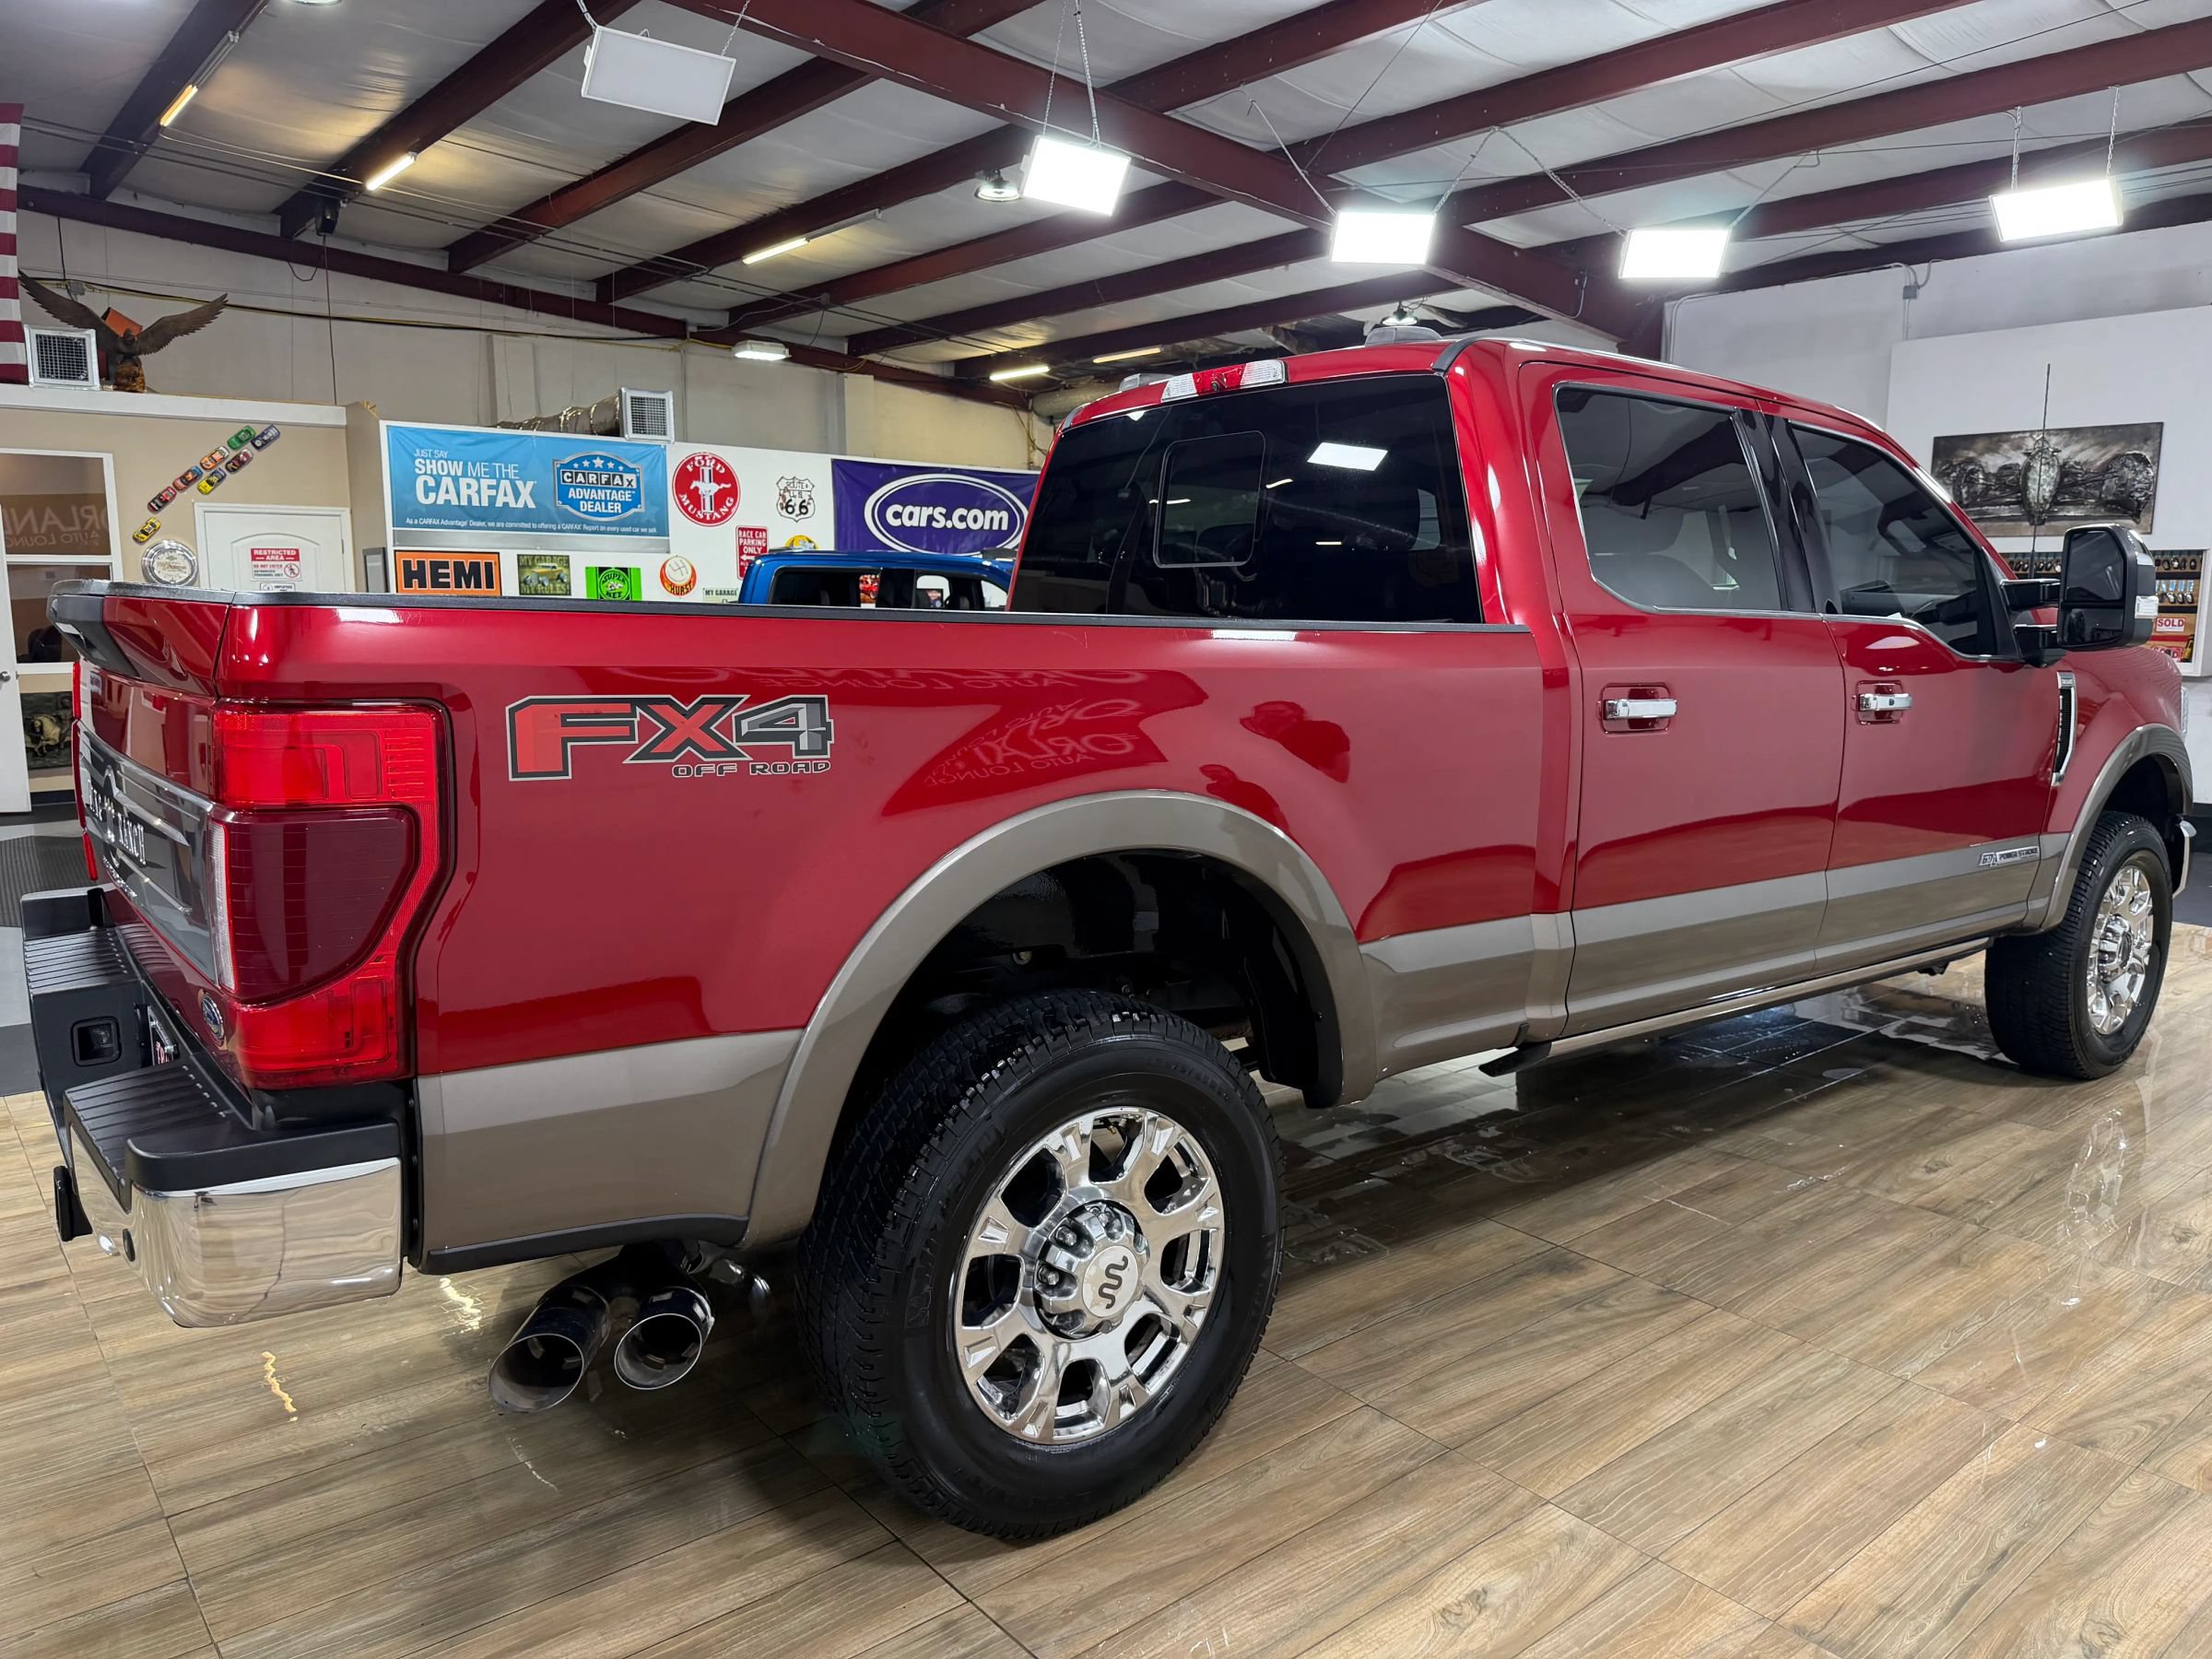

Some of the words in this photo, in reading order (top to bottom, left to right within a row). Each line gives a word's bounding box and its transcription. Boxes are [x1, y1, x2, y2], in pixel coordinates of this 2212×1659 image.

[414, 449, 432, 458] JUST
[434, 450, 448, 459] SAY
[414, 458, 464, 477] SHOW
[467, 462, 490, 477] ME
[492, 463, 520, 479] THE
[686, 454, 726, 474] FORD
[563, 472, 634, 488] CARFAX
[415, 475, 536, 509] CARFAX
[568, 488, 632, 501] ADVANTAGE
[580, 500, 622, 513] DEALER
[679, 493, 735, 521] MUSTANG
[886, 504, 1009, 531] cars.com
[738, 530, 754, 538] RACE
[755, 531, 767, 539] CAR
[739, 538, 767, 547] PARKING
[743, 546, 763, 554] ONLY
[402, 559, 495, 590] HEMI
[670, 580, 693, 595] HURST
[2158, 618, 2184, 628] SOLD
[506, 694, 834, 781] FX4
[671, 764, 737, 778] OFF
[749, 760, 831, 775] ROAD
